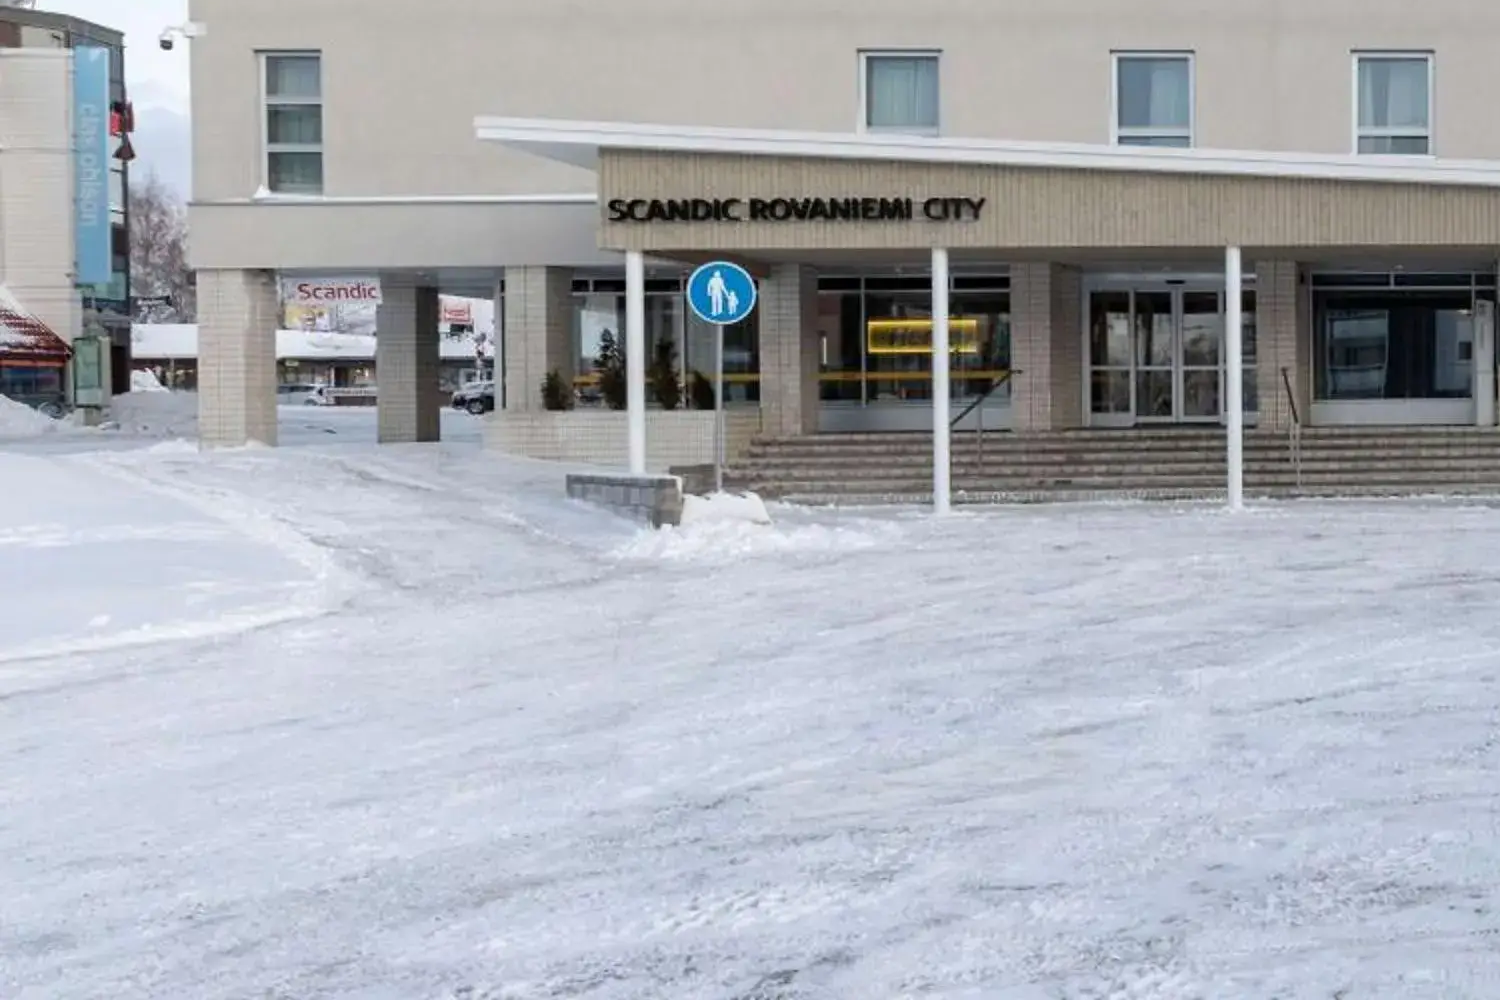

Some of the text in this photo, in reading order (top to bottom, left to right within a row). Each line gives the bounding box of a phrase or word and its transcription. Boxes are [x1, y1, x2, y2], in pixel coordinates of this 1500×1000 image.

[608, 198, 986, 222] SCANDIC ROVANIEMI CITY
[298, 283, 378, 300] Scandic
